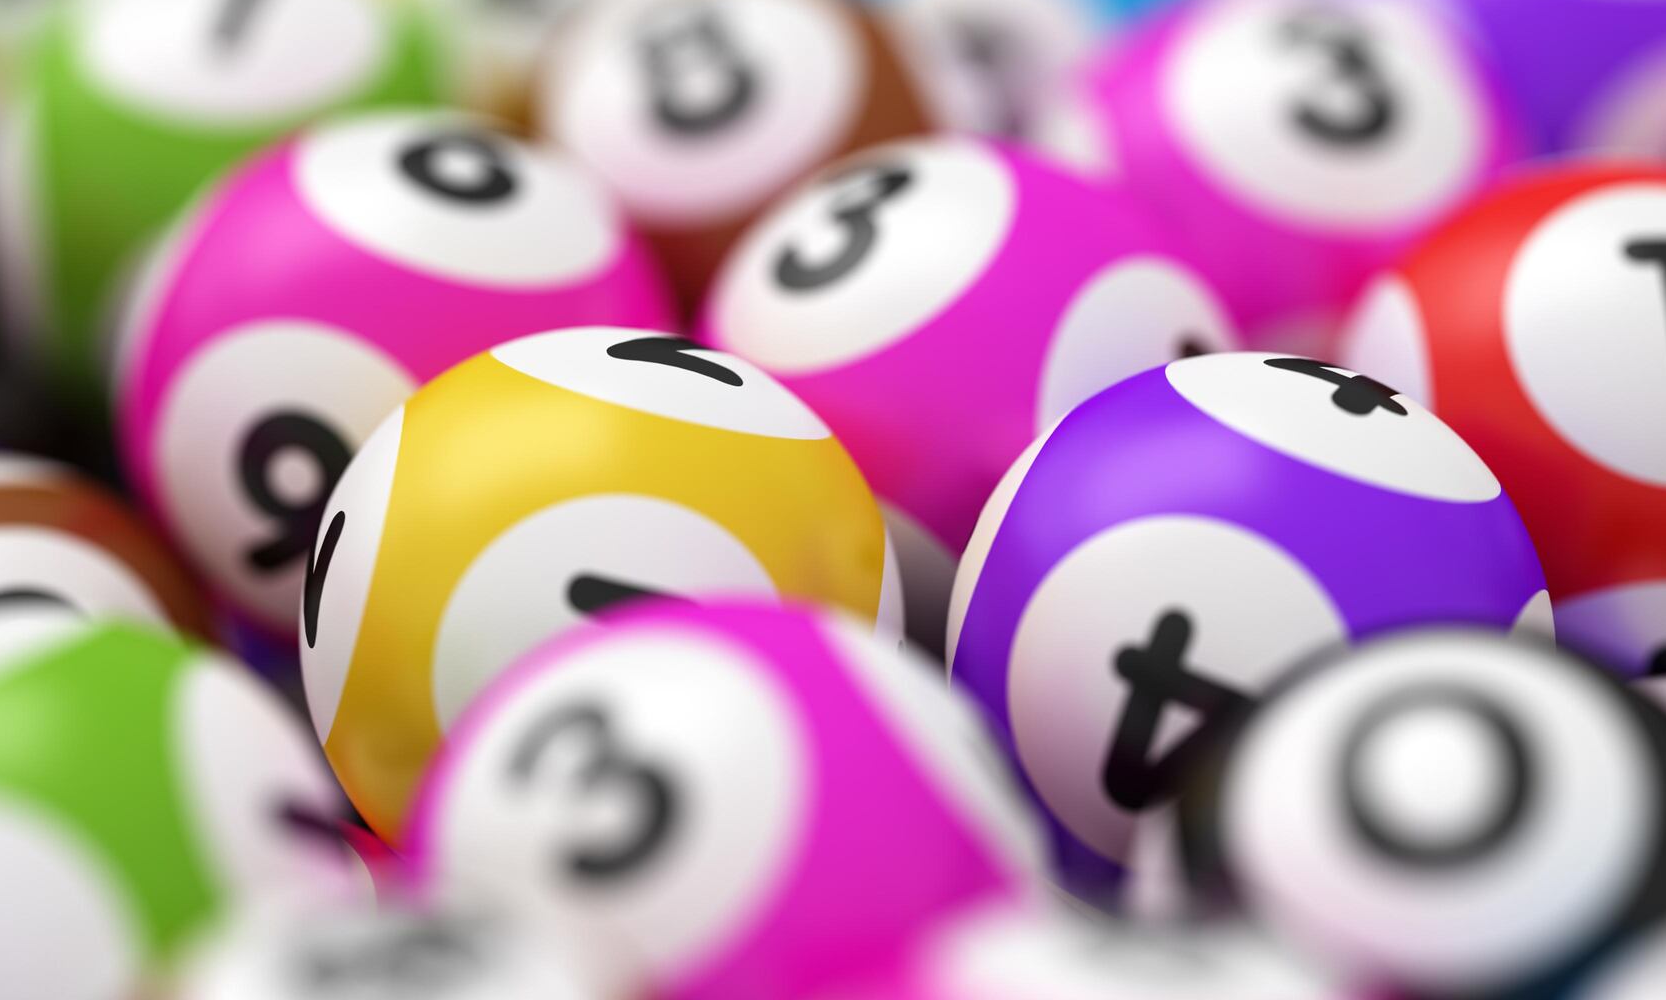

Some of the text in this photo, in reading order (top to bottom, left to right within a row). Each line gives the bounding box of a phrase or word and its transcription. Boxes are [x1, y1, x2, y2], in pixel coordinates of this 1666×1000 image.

[1271, 0, 1403, 148] 3
[770, 157, 918, 294] 3
[503, 690, 693, 890] 3
[1101, 605, 1263, 814] 4
[1336, 680, 1545, 877] 0
